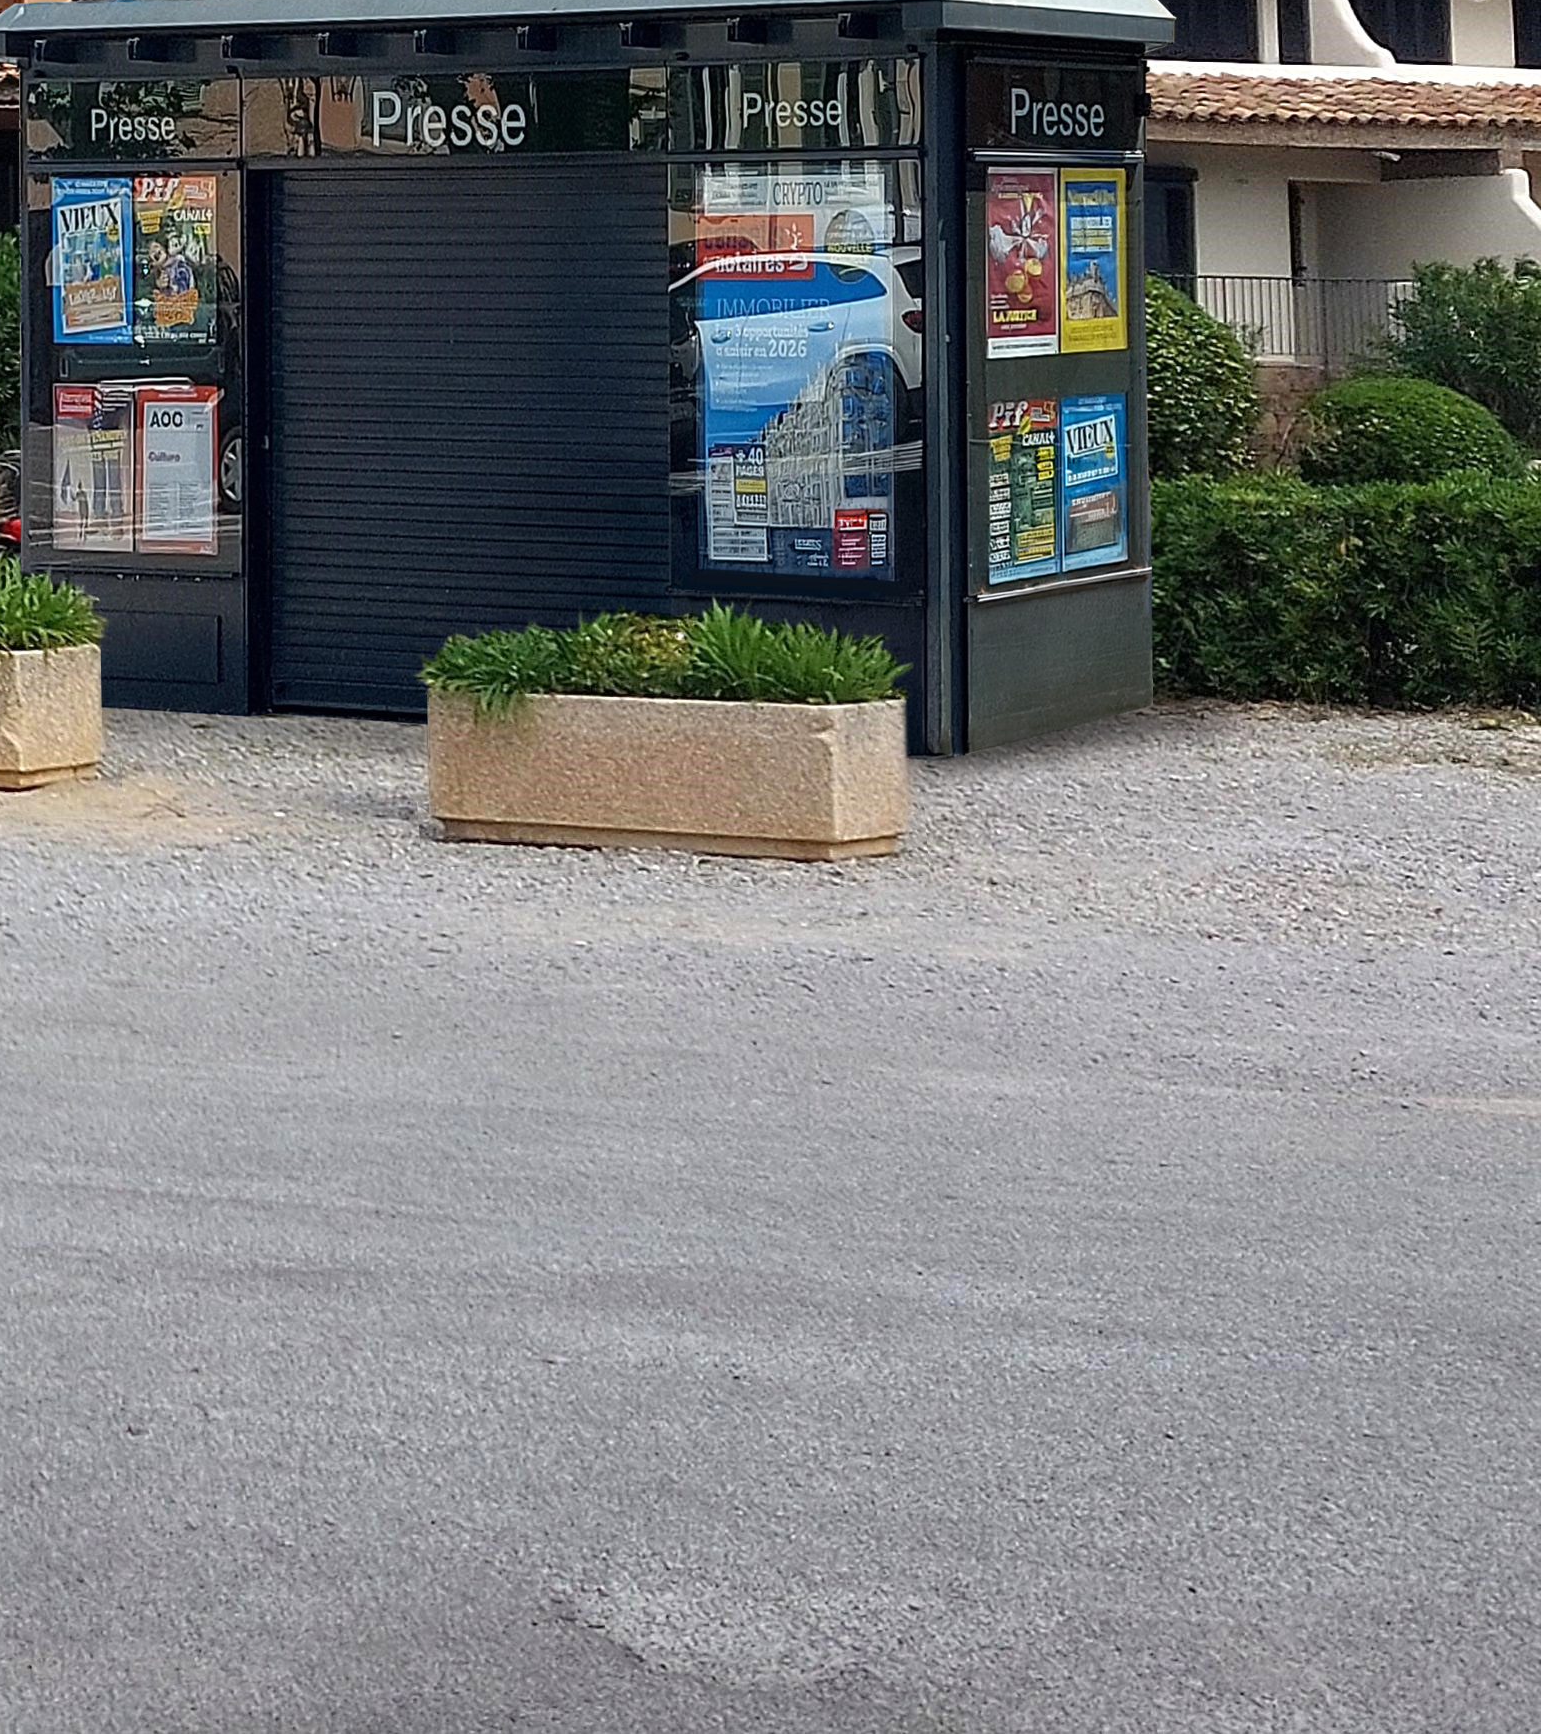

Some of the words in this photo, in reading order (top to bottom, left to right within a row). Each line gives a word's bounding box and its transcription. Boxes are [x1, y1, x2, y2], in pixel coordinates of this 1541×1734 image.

[372, 90, 527, 147] Presse
[743, 92, 843, 129] Presse
[1009, 86, 1105, 137] Presse
[90, 108, 176, 142] Presse
[136, 177, 180, 201] Pif
[773, 181, 823, 206] CRYPTO
[59, 201, 120, 233] VIEUX
[173, 208, 213, 222] CANAL+
[715, 249, 785, 274] notaires
[716, 298, 831, 320] IMMOBILIER
[768, 340, 807, 358] 2026
[988, 401, 1029, 428] Pif
[1066, 419, 1114, 451] VIEUX
[148, 451, 181, 463] Culture
[748, 447, 764, 465] 40
